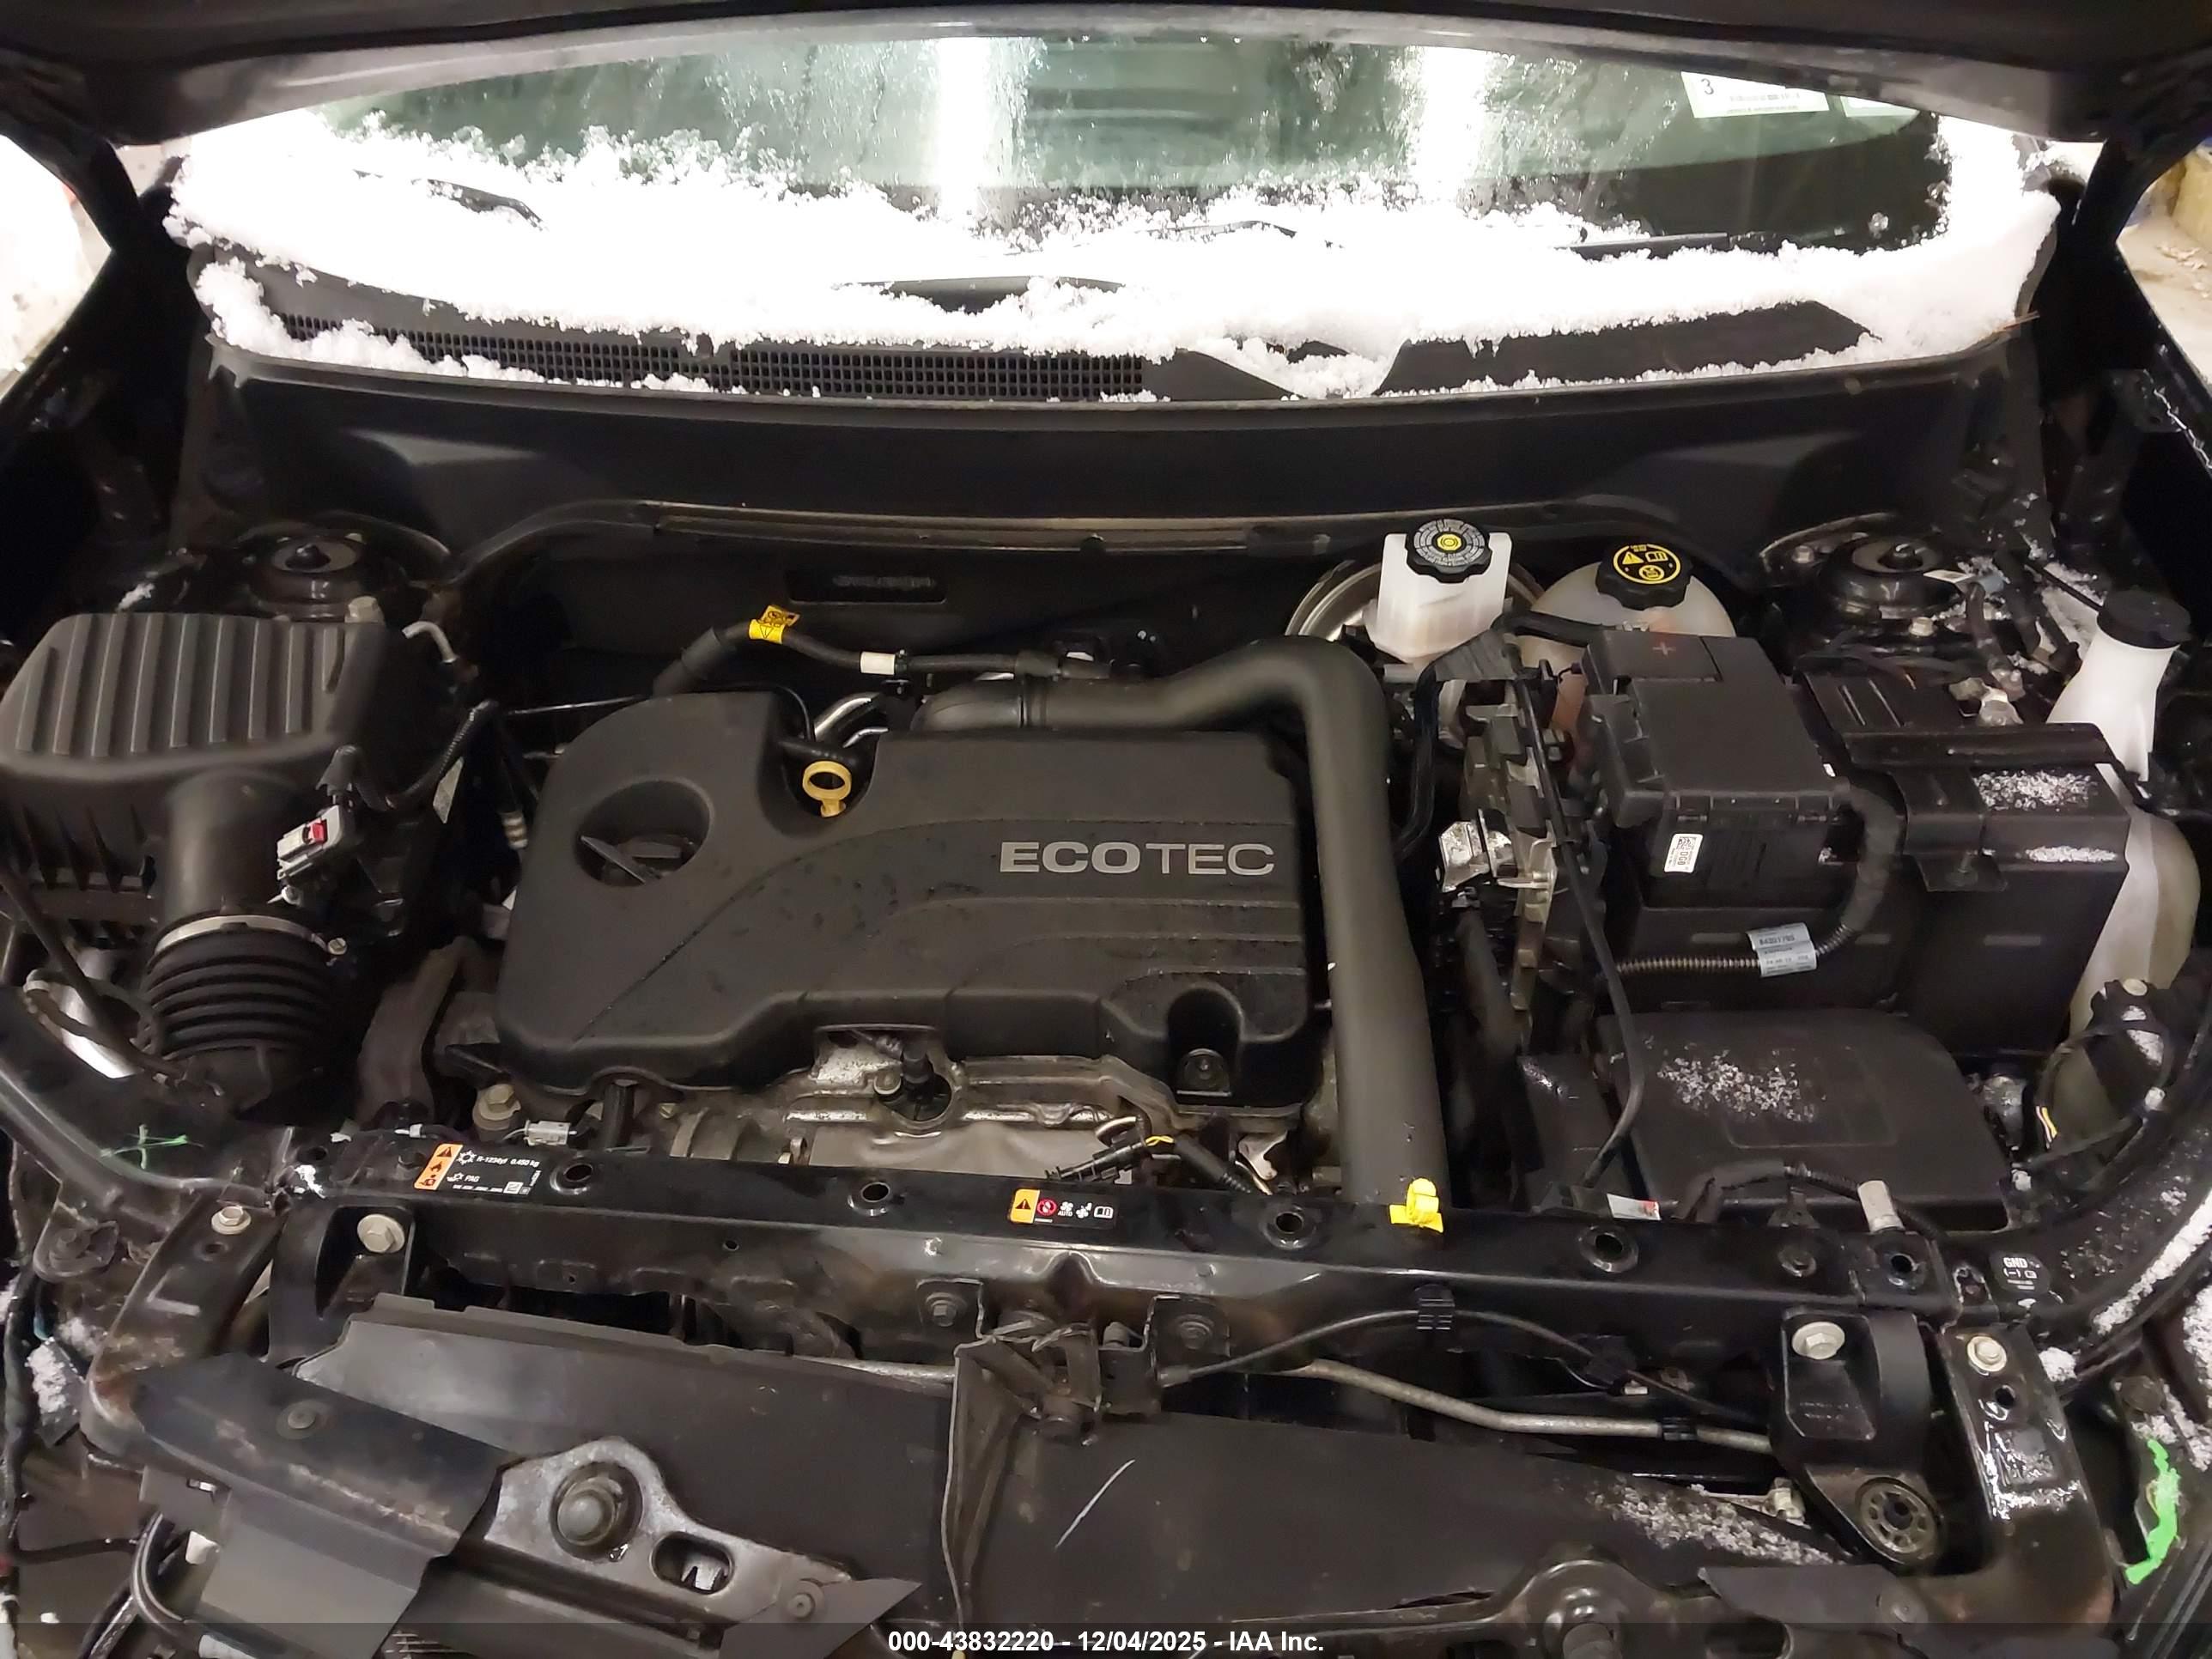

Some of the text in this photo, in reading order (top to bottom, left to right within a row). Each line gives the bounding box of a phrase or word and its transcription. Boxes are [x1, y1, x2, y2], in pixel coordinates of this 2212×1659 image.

[1000, 841, 1275, 876] ECOTEC
[464, 1174, 481, 1182] PAG
[2003, 1257, 2028, 1267] GND
